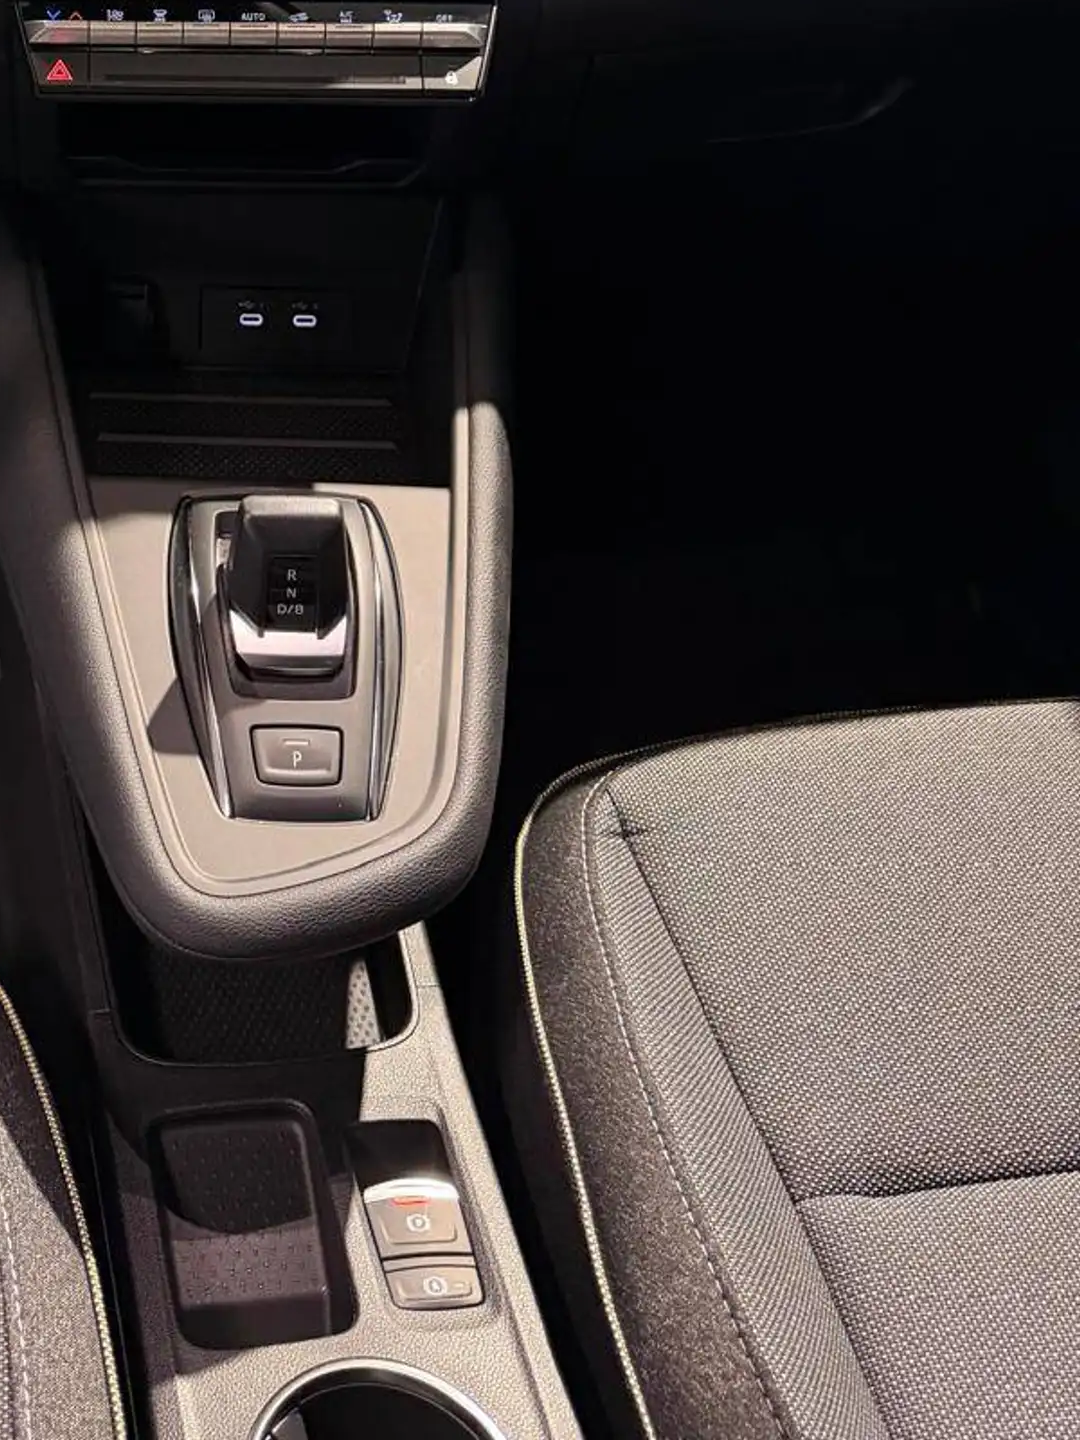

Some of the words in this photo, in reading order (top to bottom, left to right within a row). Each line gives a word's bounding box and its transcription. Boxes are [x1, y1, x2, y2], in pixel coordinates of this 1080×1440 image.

[241, 13, 266, 21] AUTO
[286, 569, 298, 581] R
[286, 588, 297, 599] N
[293, 751, 302, 768] P
